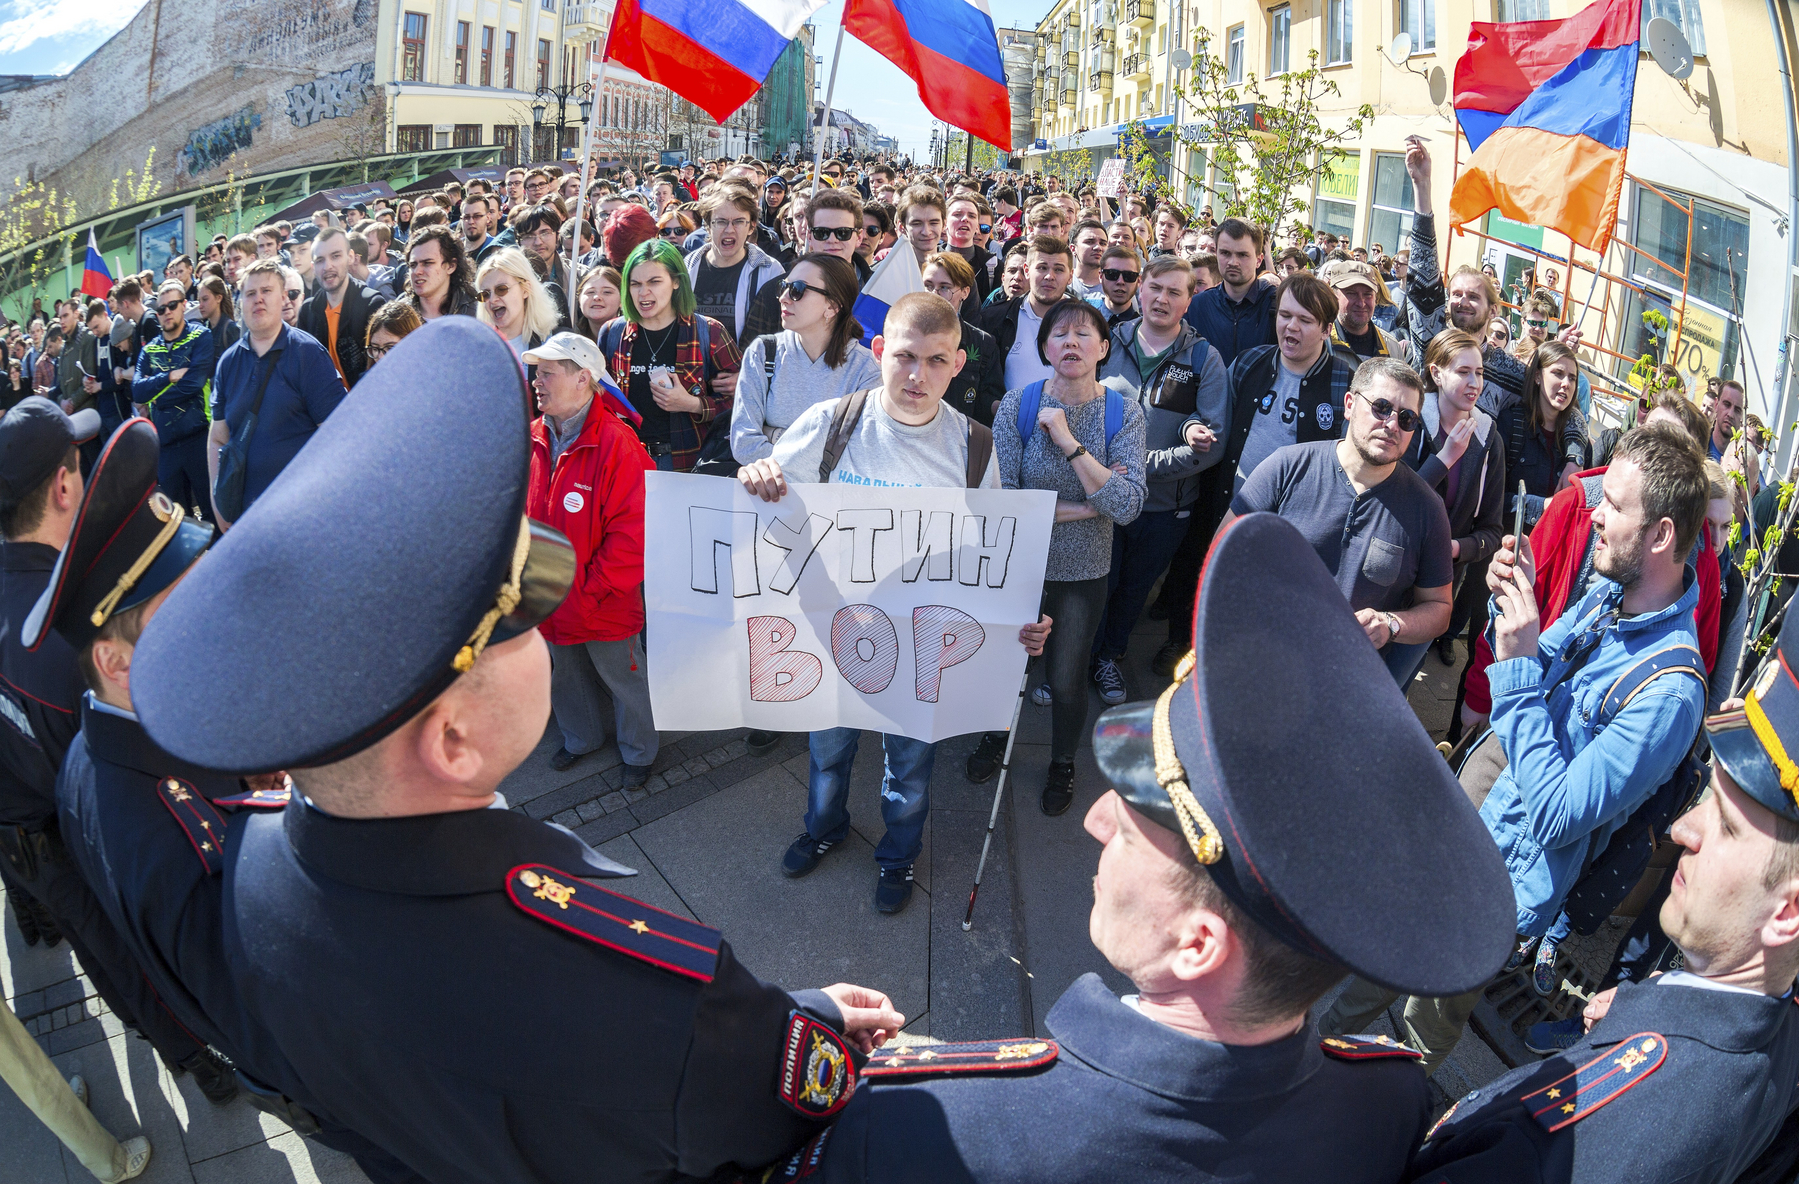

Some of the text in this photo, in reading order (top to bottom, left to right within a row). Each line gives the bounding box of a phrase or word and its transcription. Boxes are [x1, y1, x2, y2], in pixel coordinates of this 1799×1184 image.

[1673, 323, 1716, 349] РСПРОДАЖА
[689, 506, 1017, 598] ПУТИН
[747, 603, 986, 703] ВОР
[783, 1019, 805, 1095] ПОЛИЦИЯ
